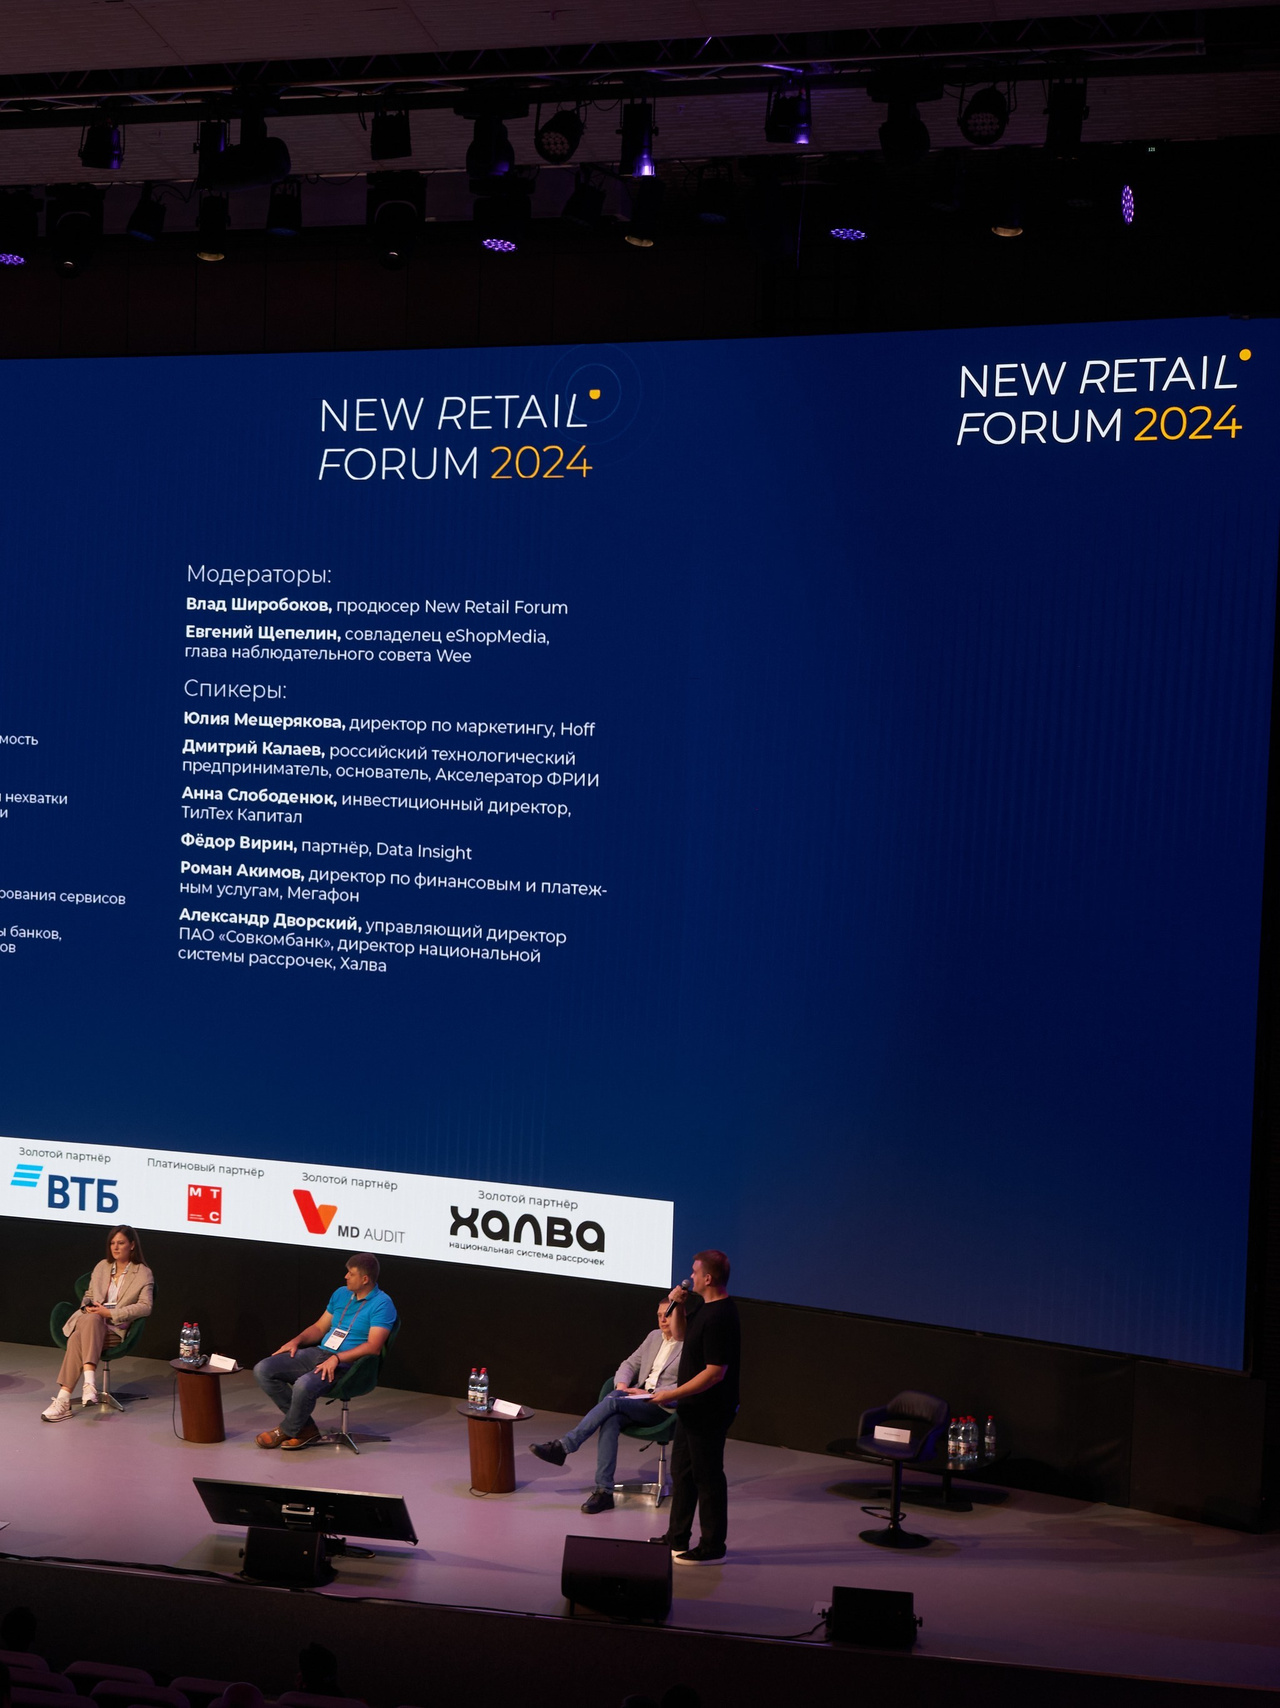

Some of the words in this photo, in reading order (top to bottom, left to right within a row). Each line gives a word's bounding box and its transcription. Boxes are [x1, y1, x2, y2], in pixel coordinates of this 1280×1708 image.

[960, 361, 1067, 398] NEW
[1079, 355, 1238, 394] RETAIL
[321, 397, 424, 432] NEW
[438, 393, 587, 430] RETAIL
[957, 408, 1121, 446] FORUM
[1134, 405, 1243, 441] 2024
[318, 446, 477, 480] FORUM
[491, 445, 593, 479] 2024
[188, 564, 331, 587] Модераторы:
[186, 597, 227, 612] Влад
[231, 597, 332, 614] Широбоков,
[337, 601, 420, 616] продюсер
[425, 600, 460, 613] New
[465, 600, 509, 614] Retail
[515, 600, 568, 614] Forum
[186, 625, 253, 639] Евгений
[258, 626, 341, 643] Щепелин,
[345, 630, 442, 644] совладелец
[446, 628, 549, 646] eShopMedia,
[185, 647, 227, 658] глава
[232, 644, 374, 662] наблюдательного
[378, 650, 431, 662] совета
[436, 649, 472, 663] Wee
[184, 679, 286, 702] Спикеры:
[184, 711, 229, 725] Юлия
[234, 713, 346, 731] Мещерякова,
[349, 718, 427, 734] директор
[432, 721, 452, 732] по
[456, 722, 556, 738] маркетингу,
[561, 722, 596, 736] Hoff
[182, 739, 257, 757] Дмитрий
[262, 741, 325, 759] Калаев,
[330, 745, 427, 760] российский
[431, 749, 575, 765] технологический
[5, 793, 68, 805] нехватки
[181, 786, 223, 800] Анна
[227, 788, 337, 807] Слободенюк,
[342, 795, 483, 811] инвестиционный
[487, 801, 571, 818] директор,
[181, 832, 235, 851] Фёдор
[240, 836, 297, 853] Вирин,
[302, 841, 372, 858] партнёр,
[377, 842, 413, 857] Data
[418, 844, 472, 862] Insight
[10, 925, 62, 941] банков,
[179, 908, 270, 928] Александр
[273, 913, 362, 933] Дворский,
[365, 921, 482, 939] управляющий
[486, 928, 567, 947] директор
[179, 927, 214, 941] ПАО
[219, 930, 334, 951] «Совкомбанк»,
[337, 939, 415, 957] директор
[419, 944, 540, 963] национальной
[20, 1147, 62, 1158] Золотой
[66, 1153, 111, 1164] партнёр
[148, 1158, 215, 1172] Платиновый
[219, 1166, 264, 1178] партнёр
[48, 1174, 119, 1213] ВТБ
[303, 1172, 347, 1184] Золотой
[352, 1179, 397, 1192] партнёр
[479, 1190, 525, 1203] Золотой
[529, 1197, 578, 1211] партнёр
[338, 1225, 360, 1238] MD
[364, 1228, 405, 1243] AUDIT
[449, 1242, 514, 1254] национальная
[517, 1250, 553, 1259] система
[556, 1254, 604, 1265] рассрочек
